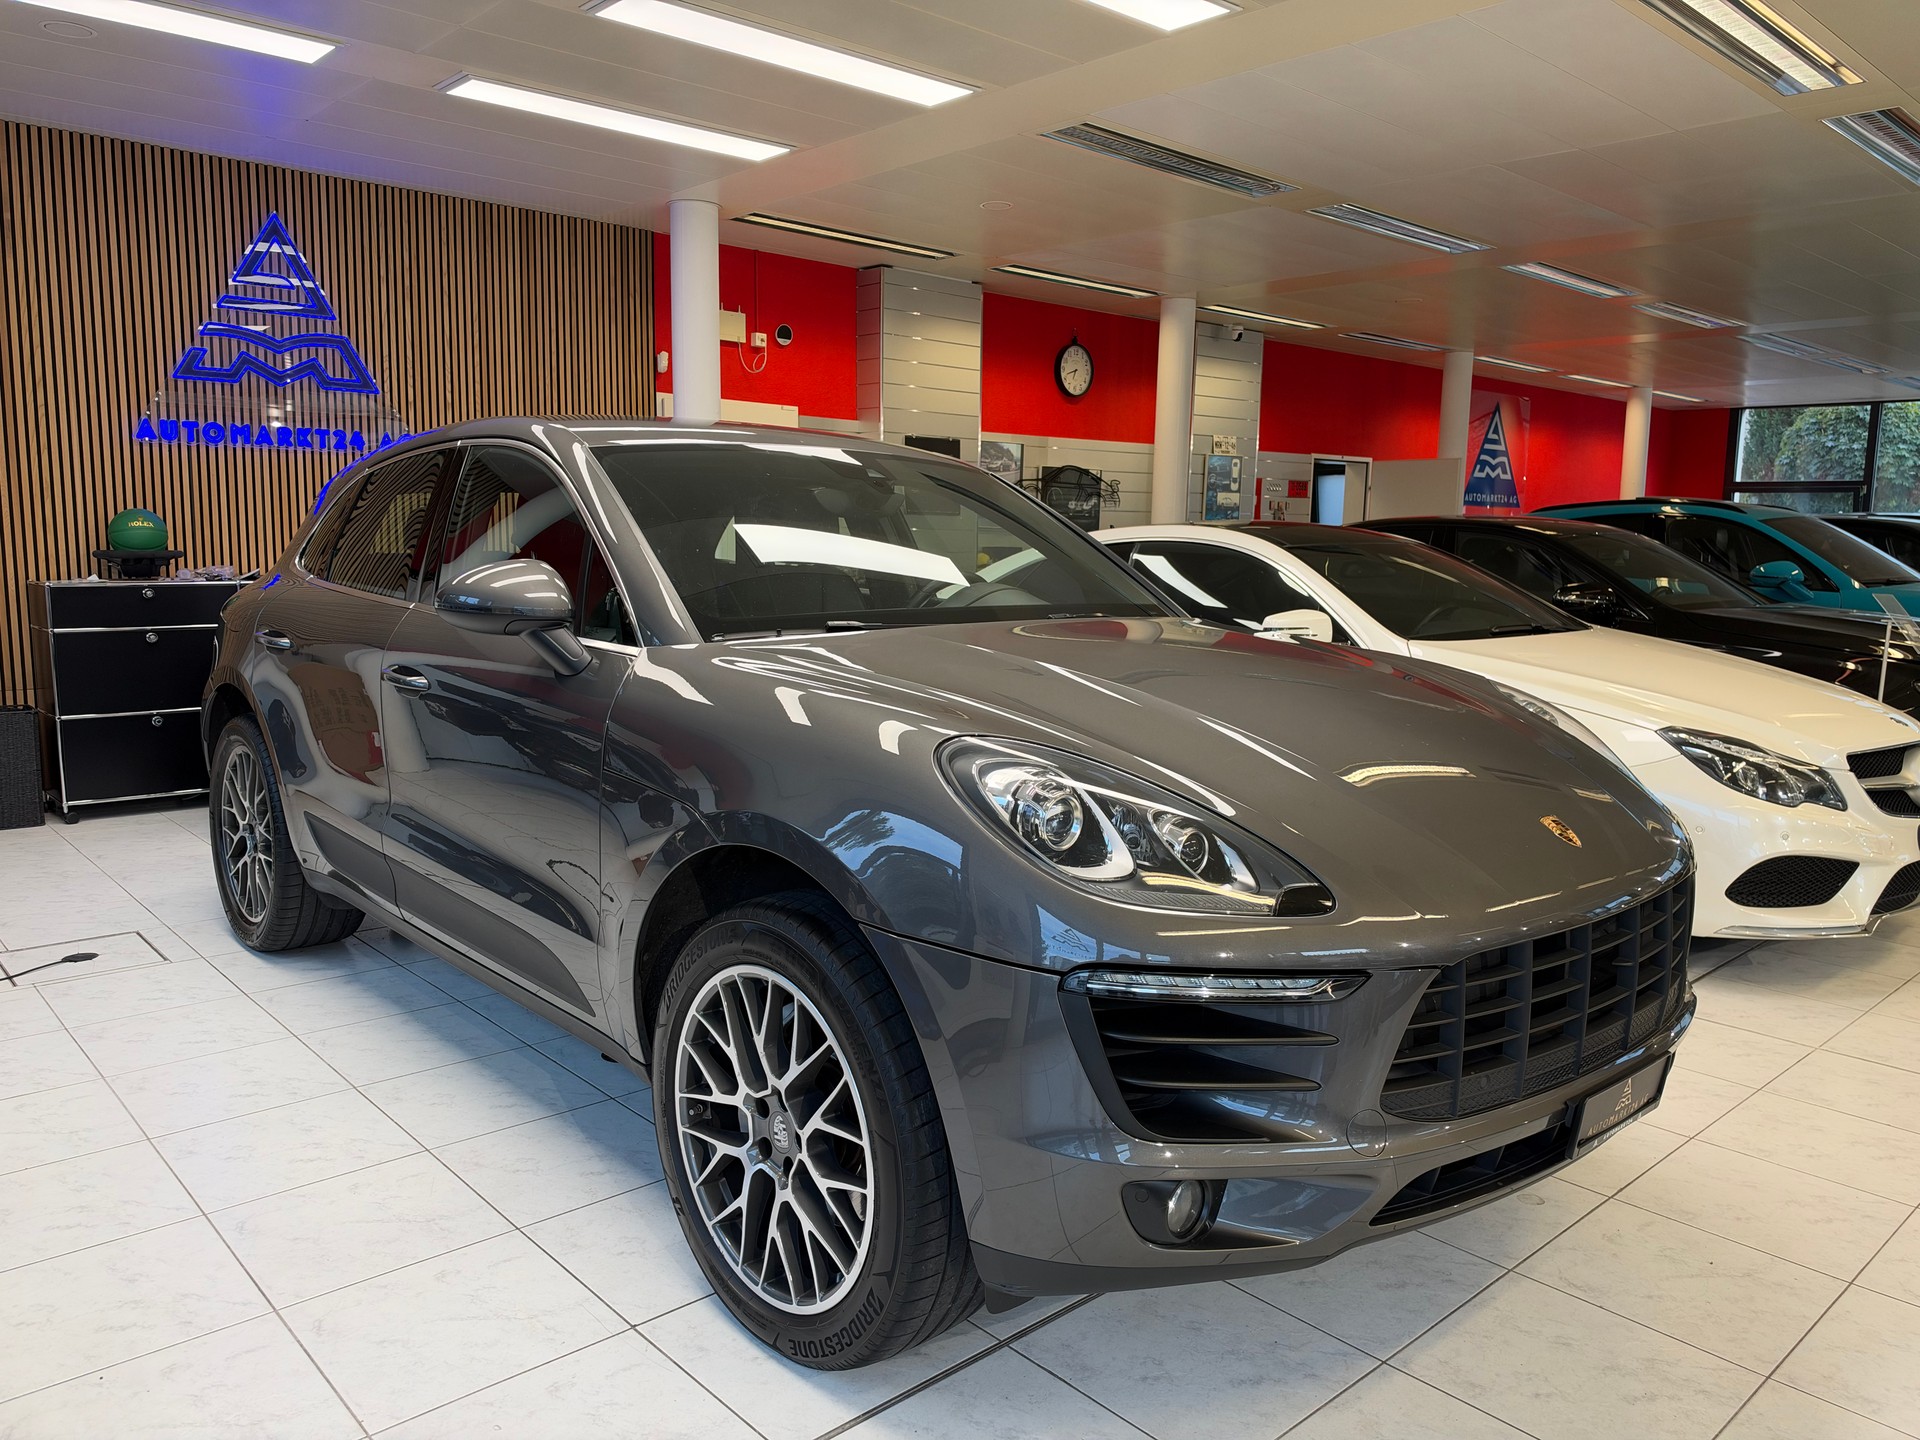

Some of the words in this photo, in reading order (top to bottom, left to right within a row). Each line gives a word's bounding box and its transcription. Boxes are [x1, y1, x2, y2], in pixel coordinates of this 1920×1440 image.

[134, 417, 366, 451] AUTOMARKT24
[1465, 493, 1508, 503] AUTOMARKT24
[1510, 495, 1517, 504] AG
[662, 926, 738, 1015] BRIDGESTONE
[1587, 1102, 1638, 1137] AUTOMARKT24
[788, 1286, 885, 1359] BRIDGESTONE
